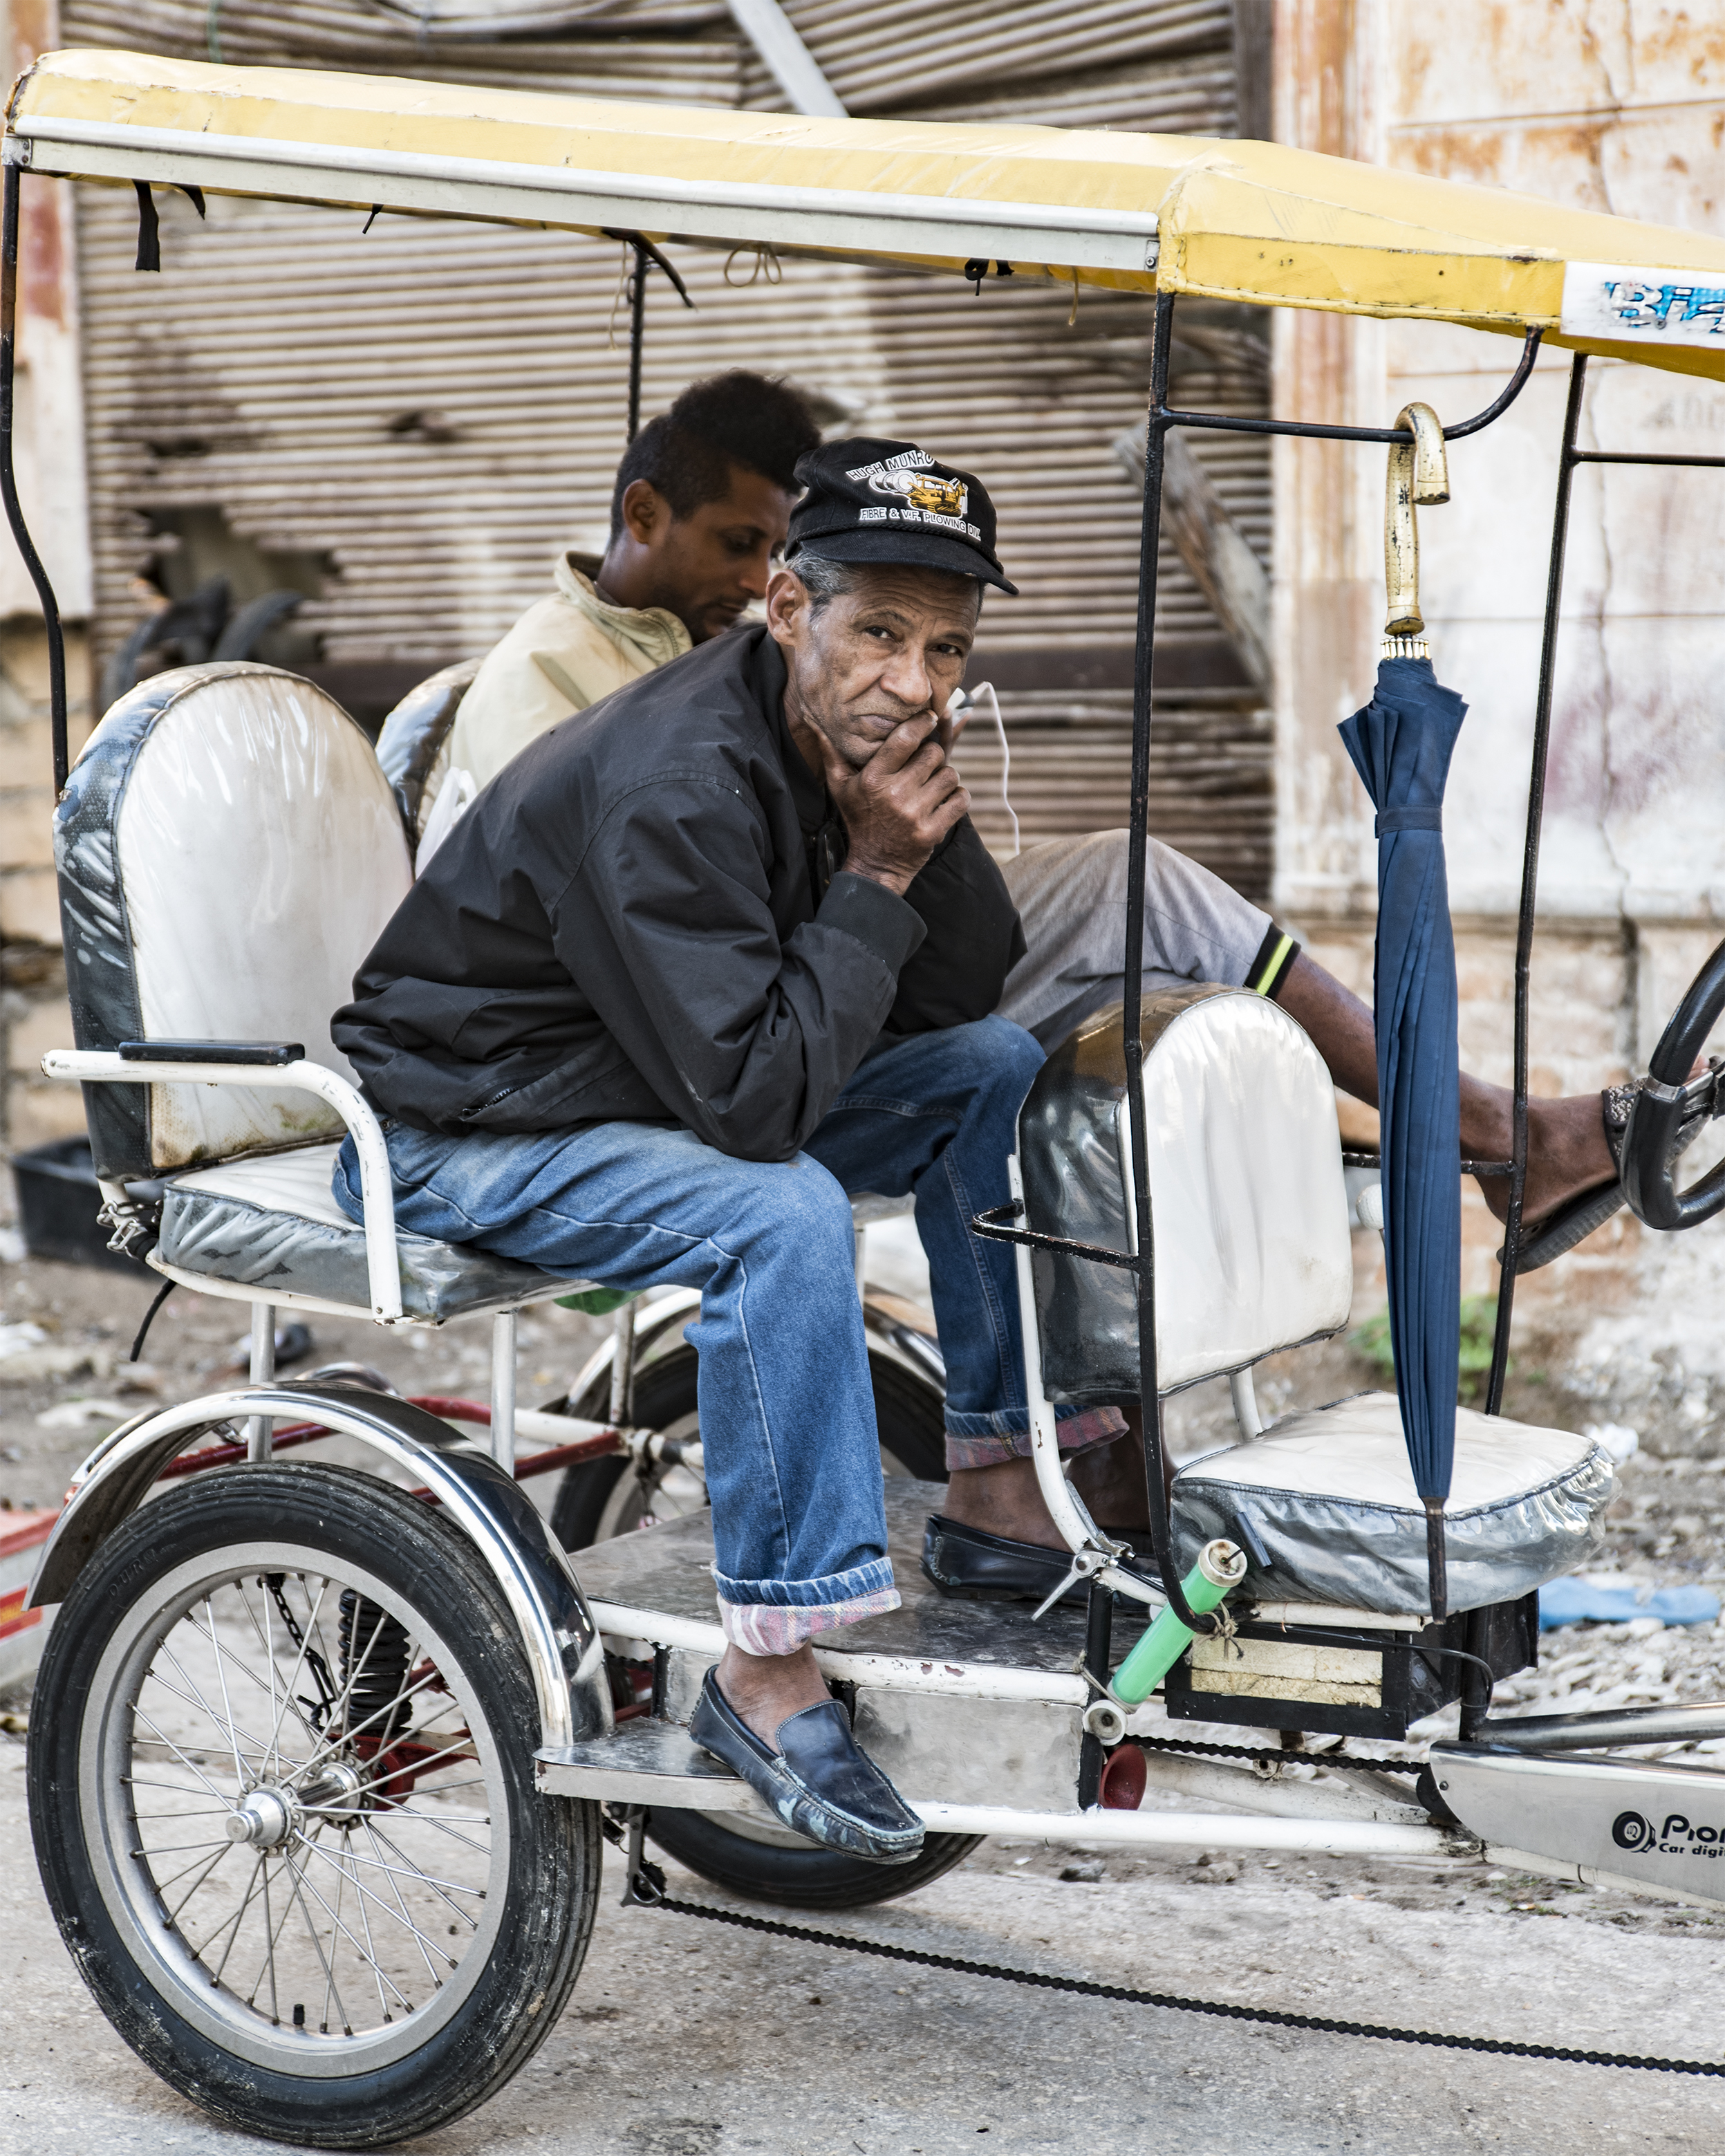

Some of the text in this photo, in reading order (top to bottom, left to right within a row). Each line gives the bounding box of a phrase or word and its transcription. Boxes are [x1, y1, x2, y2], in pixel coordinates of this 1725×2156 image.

[847, 449, 933, 479] HUGH MUNRO
[861, 508, 886, 519] FIBRE
[890, 508, 899, 519] &
[924, 513, 967, 532] PLOWING
[1659, 1842, 1725, 1859] Car digi
